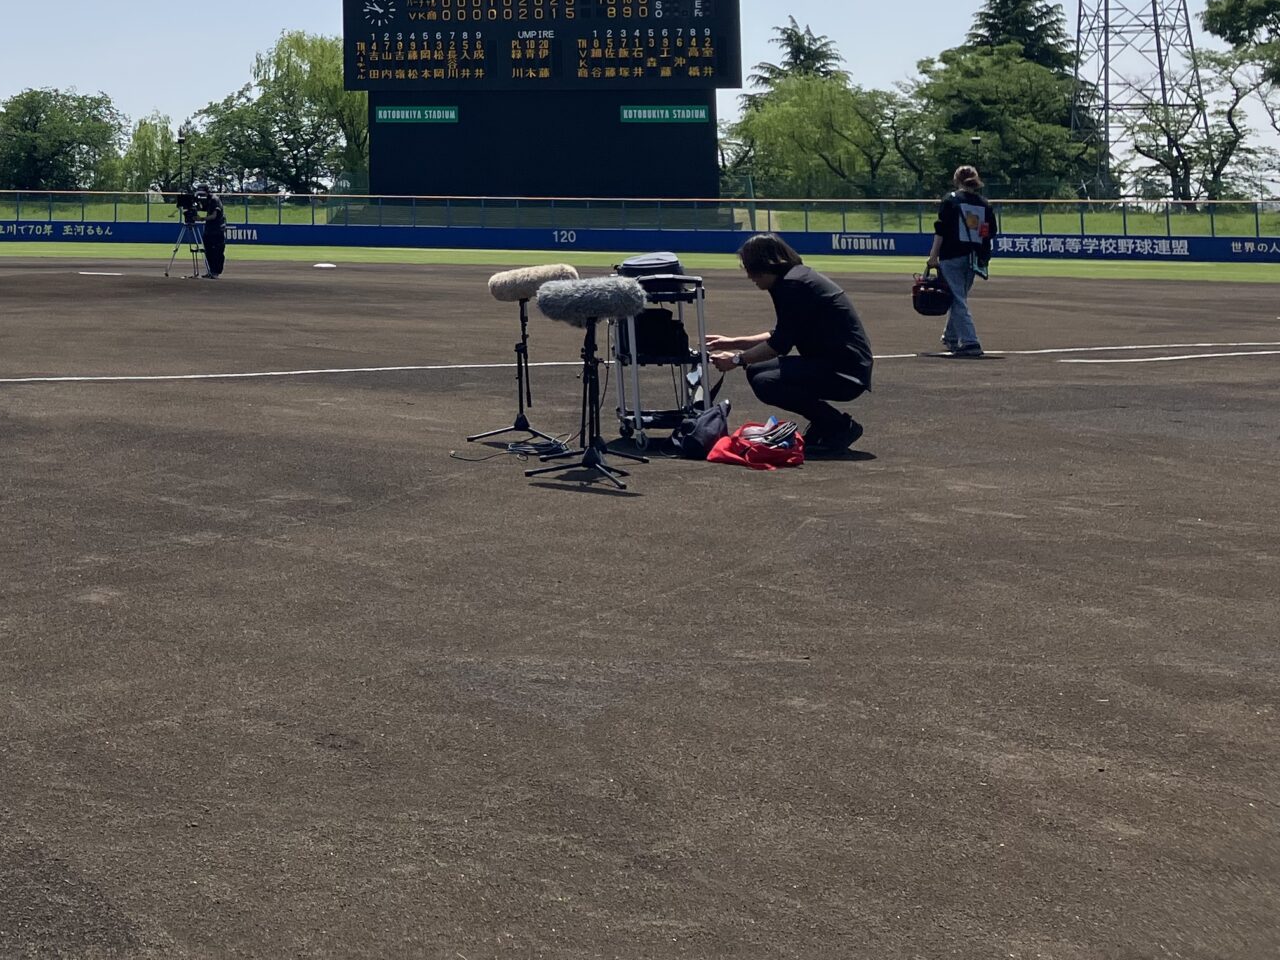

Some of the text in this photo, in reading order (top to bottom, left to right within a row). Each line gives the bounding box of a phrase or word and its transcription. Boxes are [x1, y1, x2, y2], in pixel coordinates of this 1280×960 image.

[442, 10, 450, 21] 0
[457, 9, 466, 20] 0
[473, 9, 482, 20] 0
[488, 9, 496, 20] 0
[503, 9, 512, 20] 0
[519, 8, 528, 20] 2
[535, 8, 543, 19] 0
[566, 8, 574, 18] 5
[608, 7, 616, 18] 8
[639, 7, 648, 17] 0
[518, 30, 555, 38] UMPIRE
[621, 29, 626, 37] 3
[649, 39, 654, 47] 3
[691, 38, 696, 46] 4
[704, 38, 710, 46] 2
[369, 51, 379, 79] 吉田
[382, 51, 392, 79] 山内
[633, 49, 643, 77] 石井
[378, 110, 455, 119] KOTOBUKIYA STADIUM
[623, 109, 705, 119] KOTOBUKIYA STADIUM
[552, 230, 577, 243] 120
